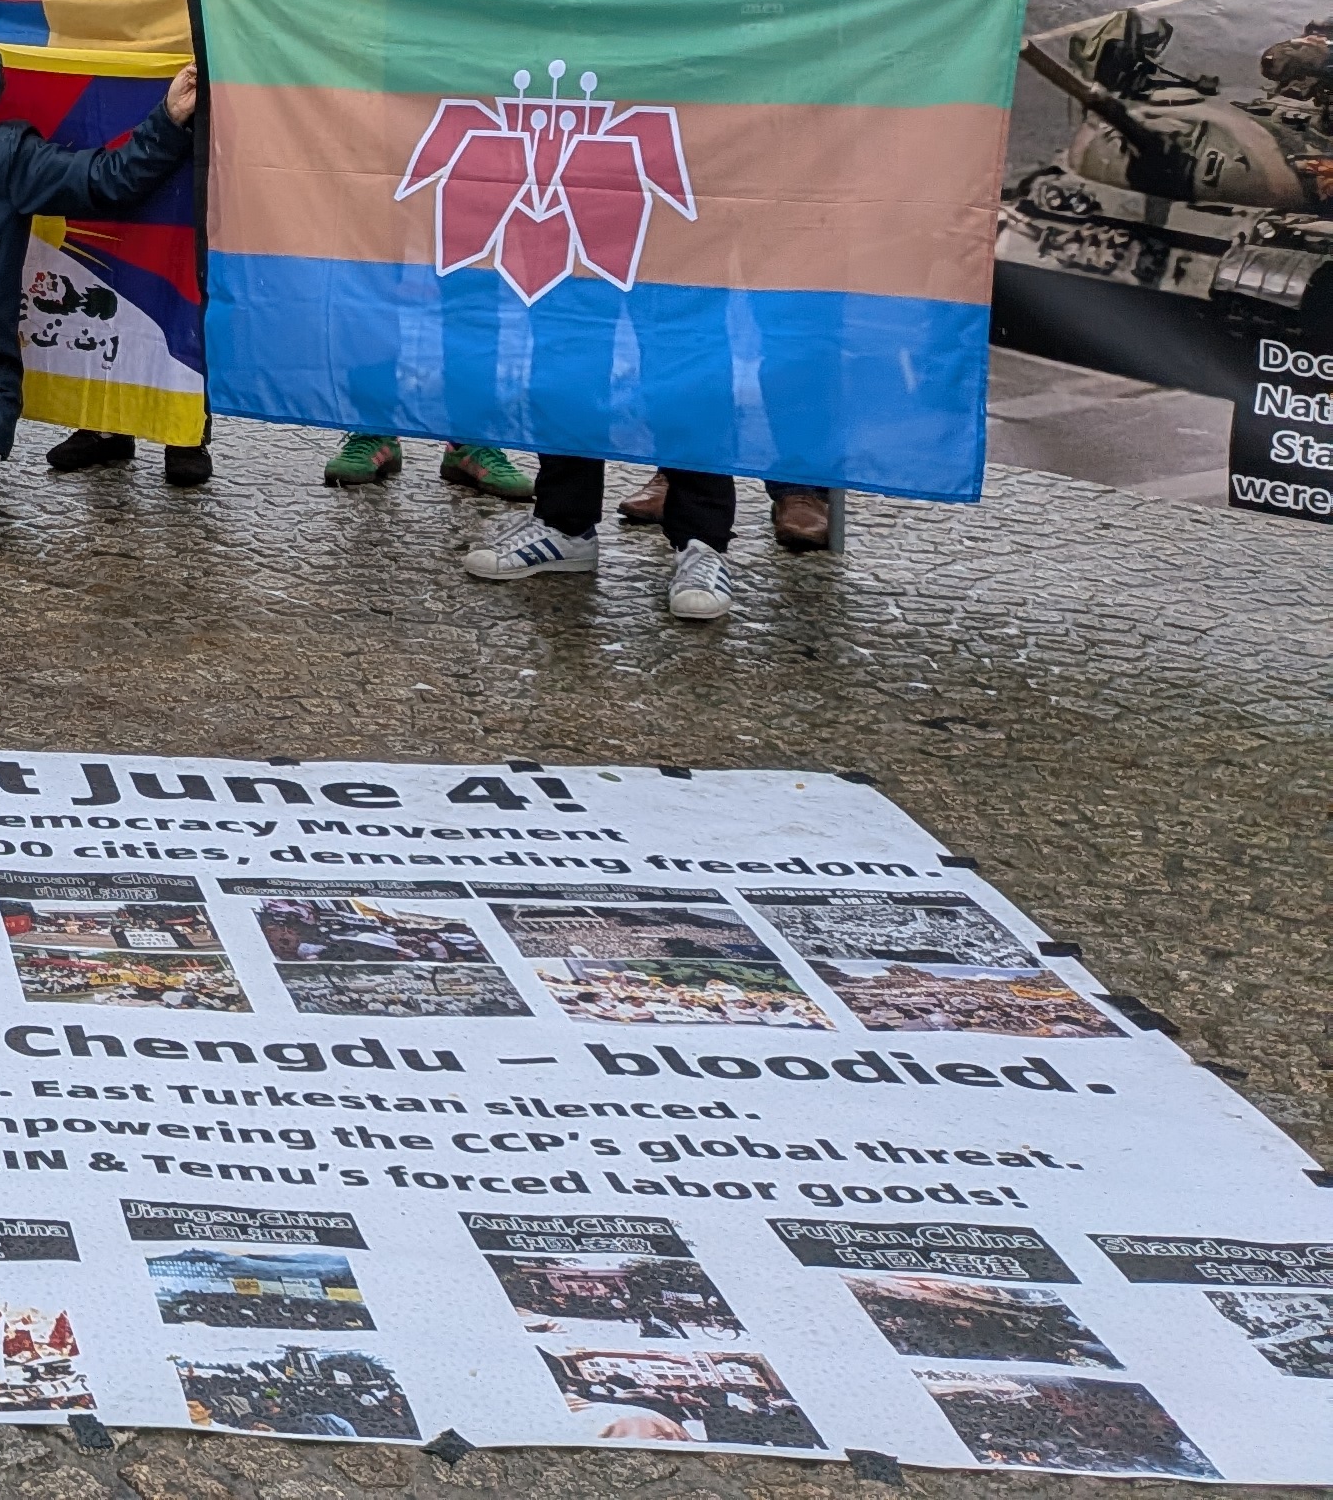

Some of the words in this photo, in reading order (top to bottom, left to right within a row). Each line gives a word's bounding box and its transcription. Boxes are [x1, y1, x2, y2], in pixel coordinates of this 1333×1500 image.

[1235, 476, 1330, 512] were
[71, 763, 402, 808] June
[446, 777, 587, 812] 4!
[297, 819, 629, 843] Movement
[74, 841, 250, 865] cities,
[270, 846, 631, 874] demanding
[644, 855, 942, 877] freedom.
[5, 1025, 466, 1072] Chengdu
[584, 1043, 1116, 1094] bloodied.
[31, 1081, 154, 1102] East
[167, 1085, 468, 1113] Turkestan
[484, 1096, 761, 1119] silenced.
[331, 1126, 433, 1149] the
[452, 1132, 621, 1155] CCP's
[639, 1135, 848, 1162] global
[854, 1141, 1084, 1170] threat.
[89, 1152, 128, 1172] &
[142, 1155, 369, 1186] Temu's
[384, 1166, 591, 1194] forced
[603, 1172, 777, 1200] labor
[798, 1183, 1028, 1208] goods!
[126, 1203, 353, 1230] Jiangsu,China
[468, 1215, 674, 1237] Anhui,China
[782, 1222, 1043, 1251] Fujian,China
